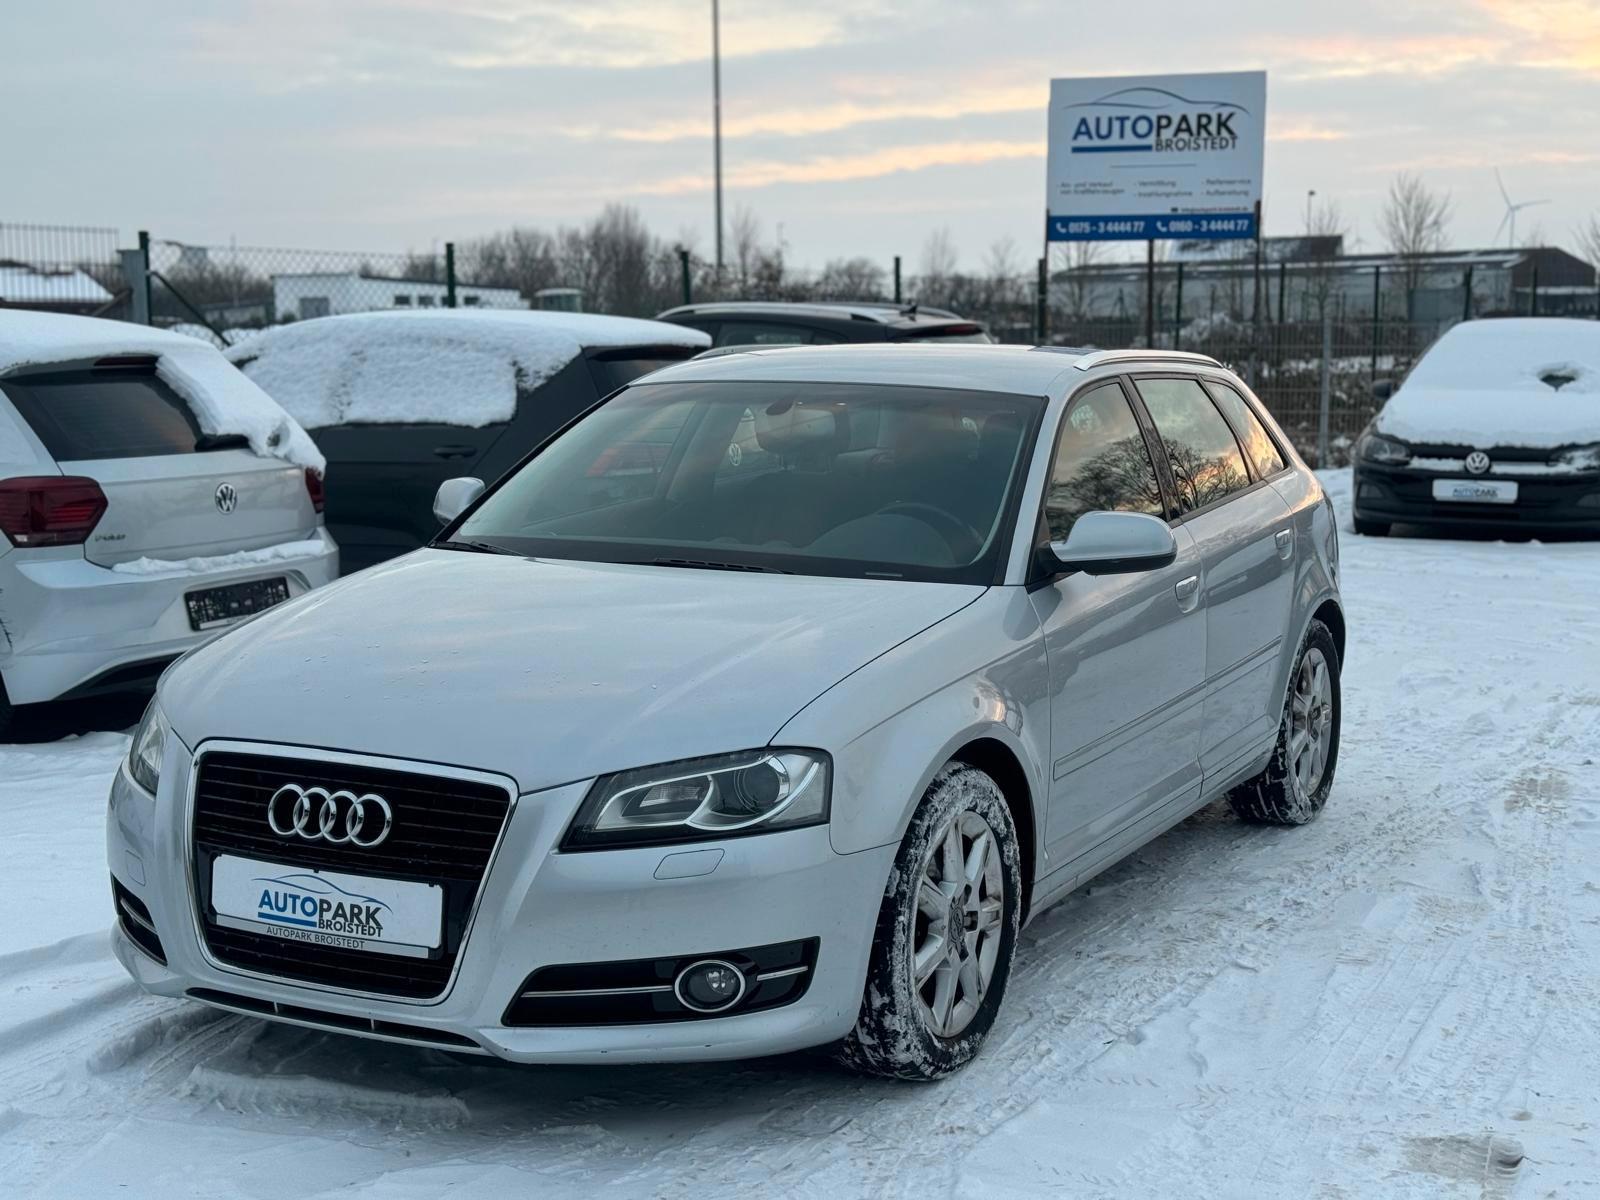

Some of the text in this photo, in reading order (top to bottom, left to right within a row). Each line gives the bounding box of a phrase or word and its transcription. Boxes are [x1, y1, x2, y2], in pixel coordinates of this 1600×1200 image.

[1072, 112, 1237, 141] AUTOPARK
[1155, 136, 1238, 152] BROISTEDT
[258, 889, 382, 927] AUTOPARK
[266, 925, 365, 949] AUTOPARK BROISTEDT
[318, 918, 383, 937] BROISTEDT
